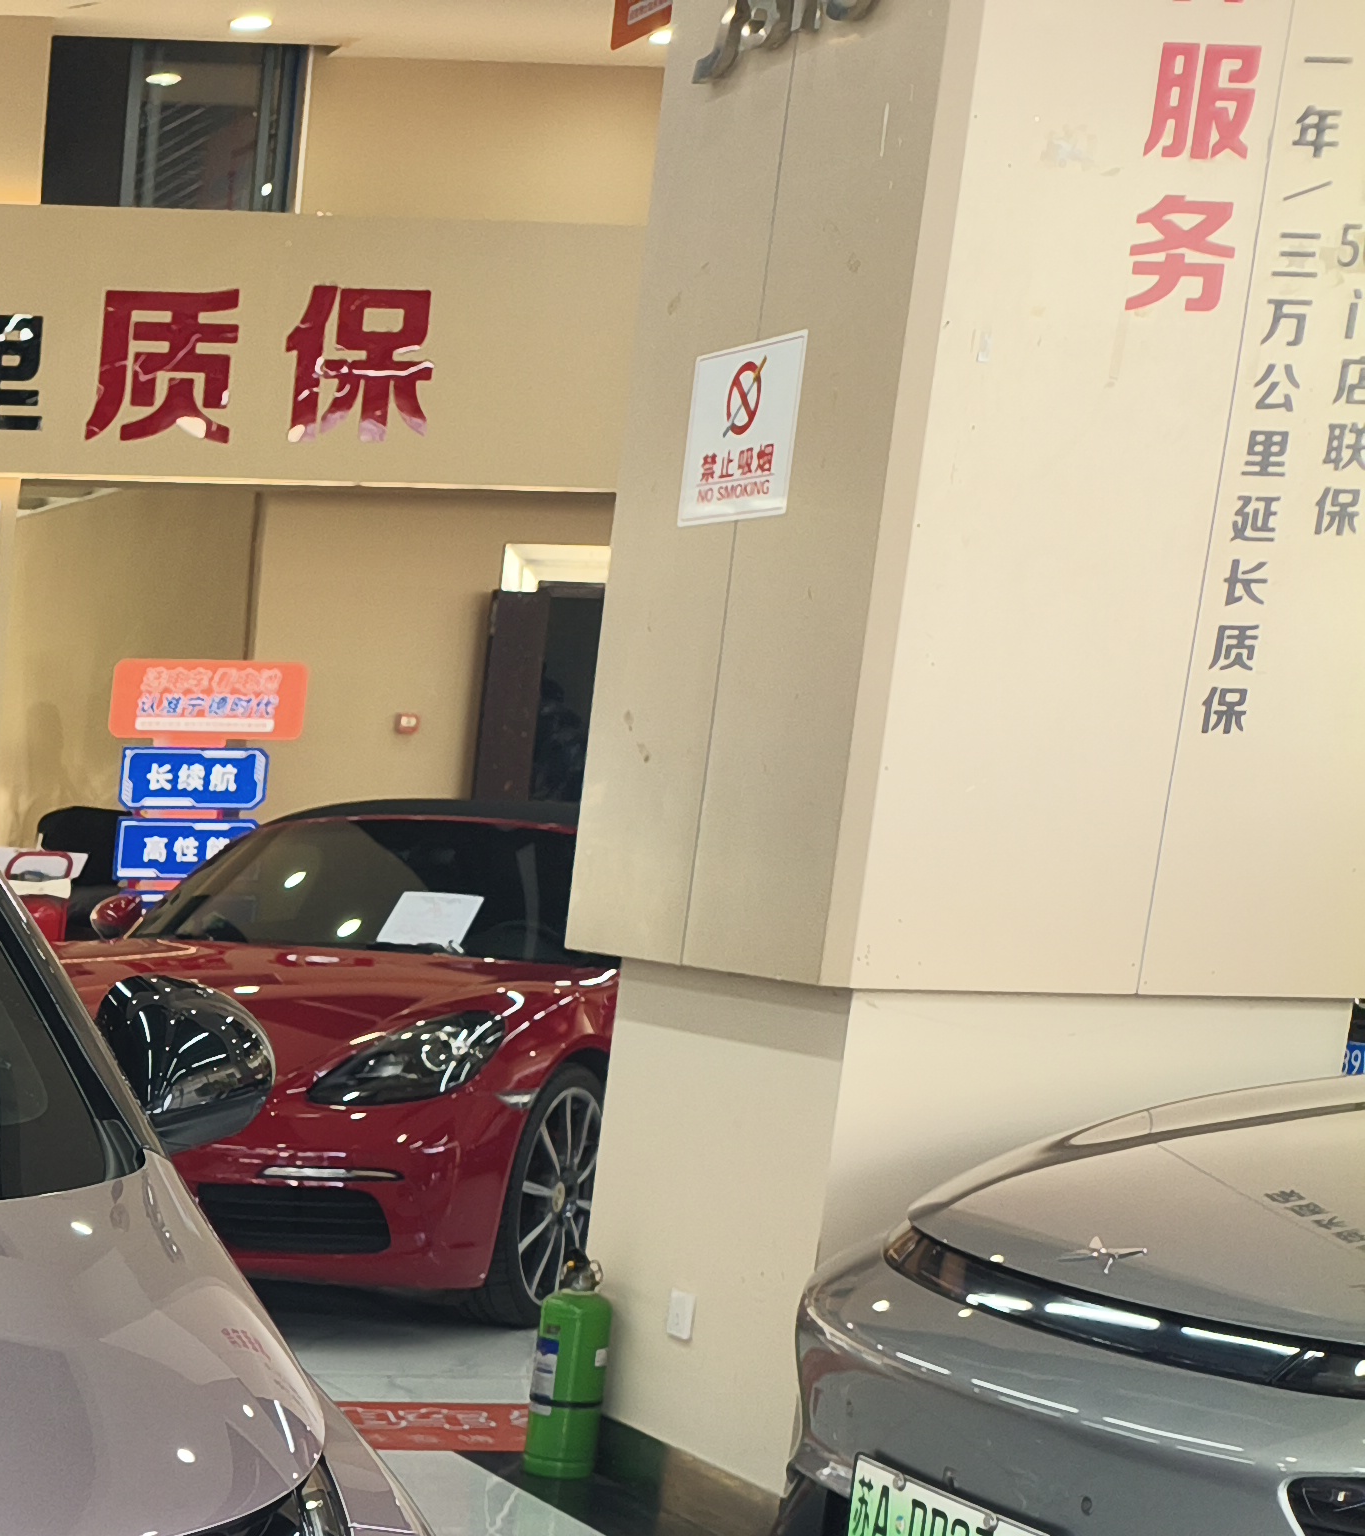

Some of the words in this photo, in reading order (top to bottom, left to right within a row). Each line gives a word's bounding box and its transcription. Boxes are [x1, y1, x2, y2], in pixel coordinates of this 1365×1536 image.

[1125, 0, 1262, 312] 服务
[1201, 56, 1353, 735] 一年/三万公里延长质保
[700, 443, 774, 482] 禁止吸烟
[696, 487, 714, 504] NO
[716, 479, 771, 502] SMOKING
[146, 762, 238, 792] 长续航
